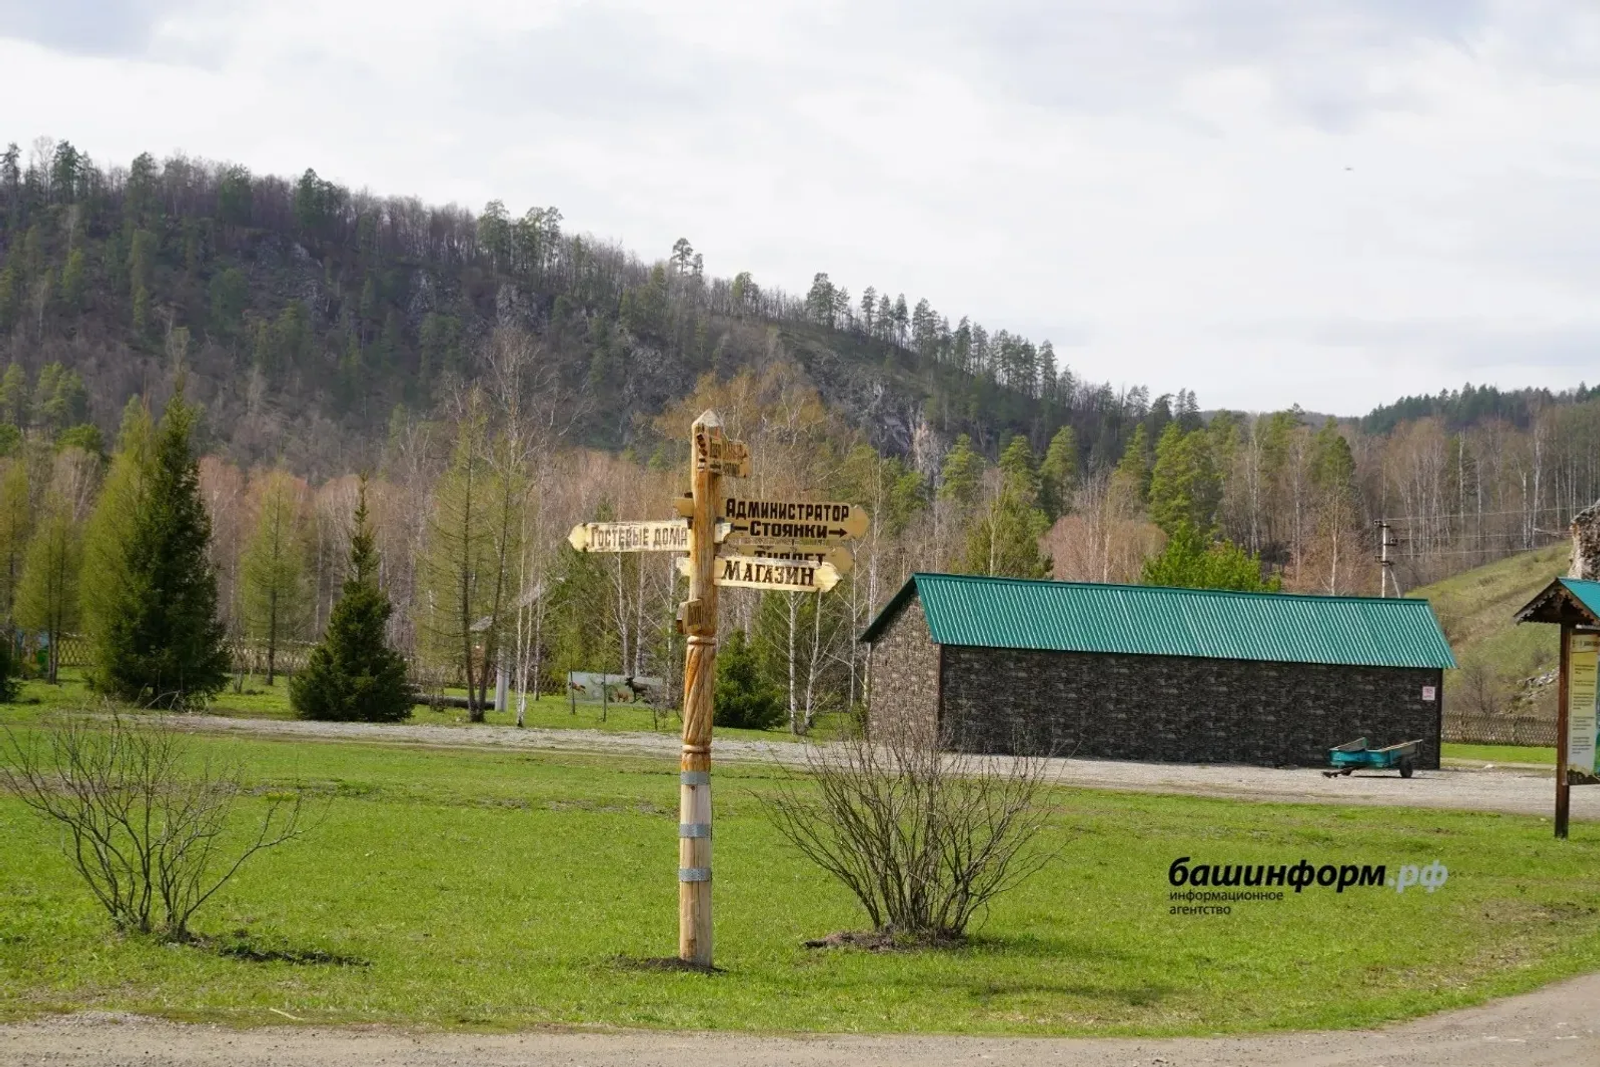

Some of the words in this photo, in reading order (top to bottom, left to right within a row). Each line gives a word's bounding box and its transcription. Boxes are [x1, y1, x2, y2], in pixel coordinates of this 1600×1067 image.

[726, 498, 849, 522] АДМИНИСТРАТОР
[750, 521, 828, 538] СТОЯНКИ
[721, 560, 815, 586] МАГАЗИН
